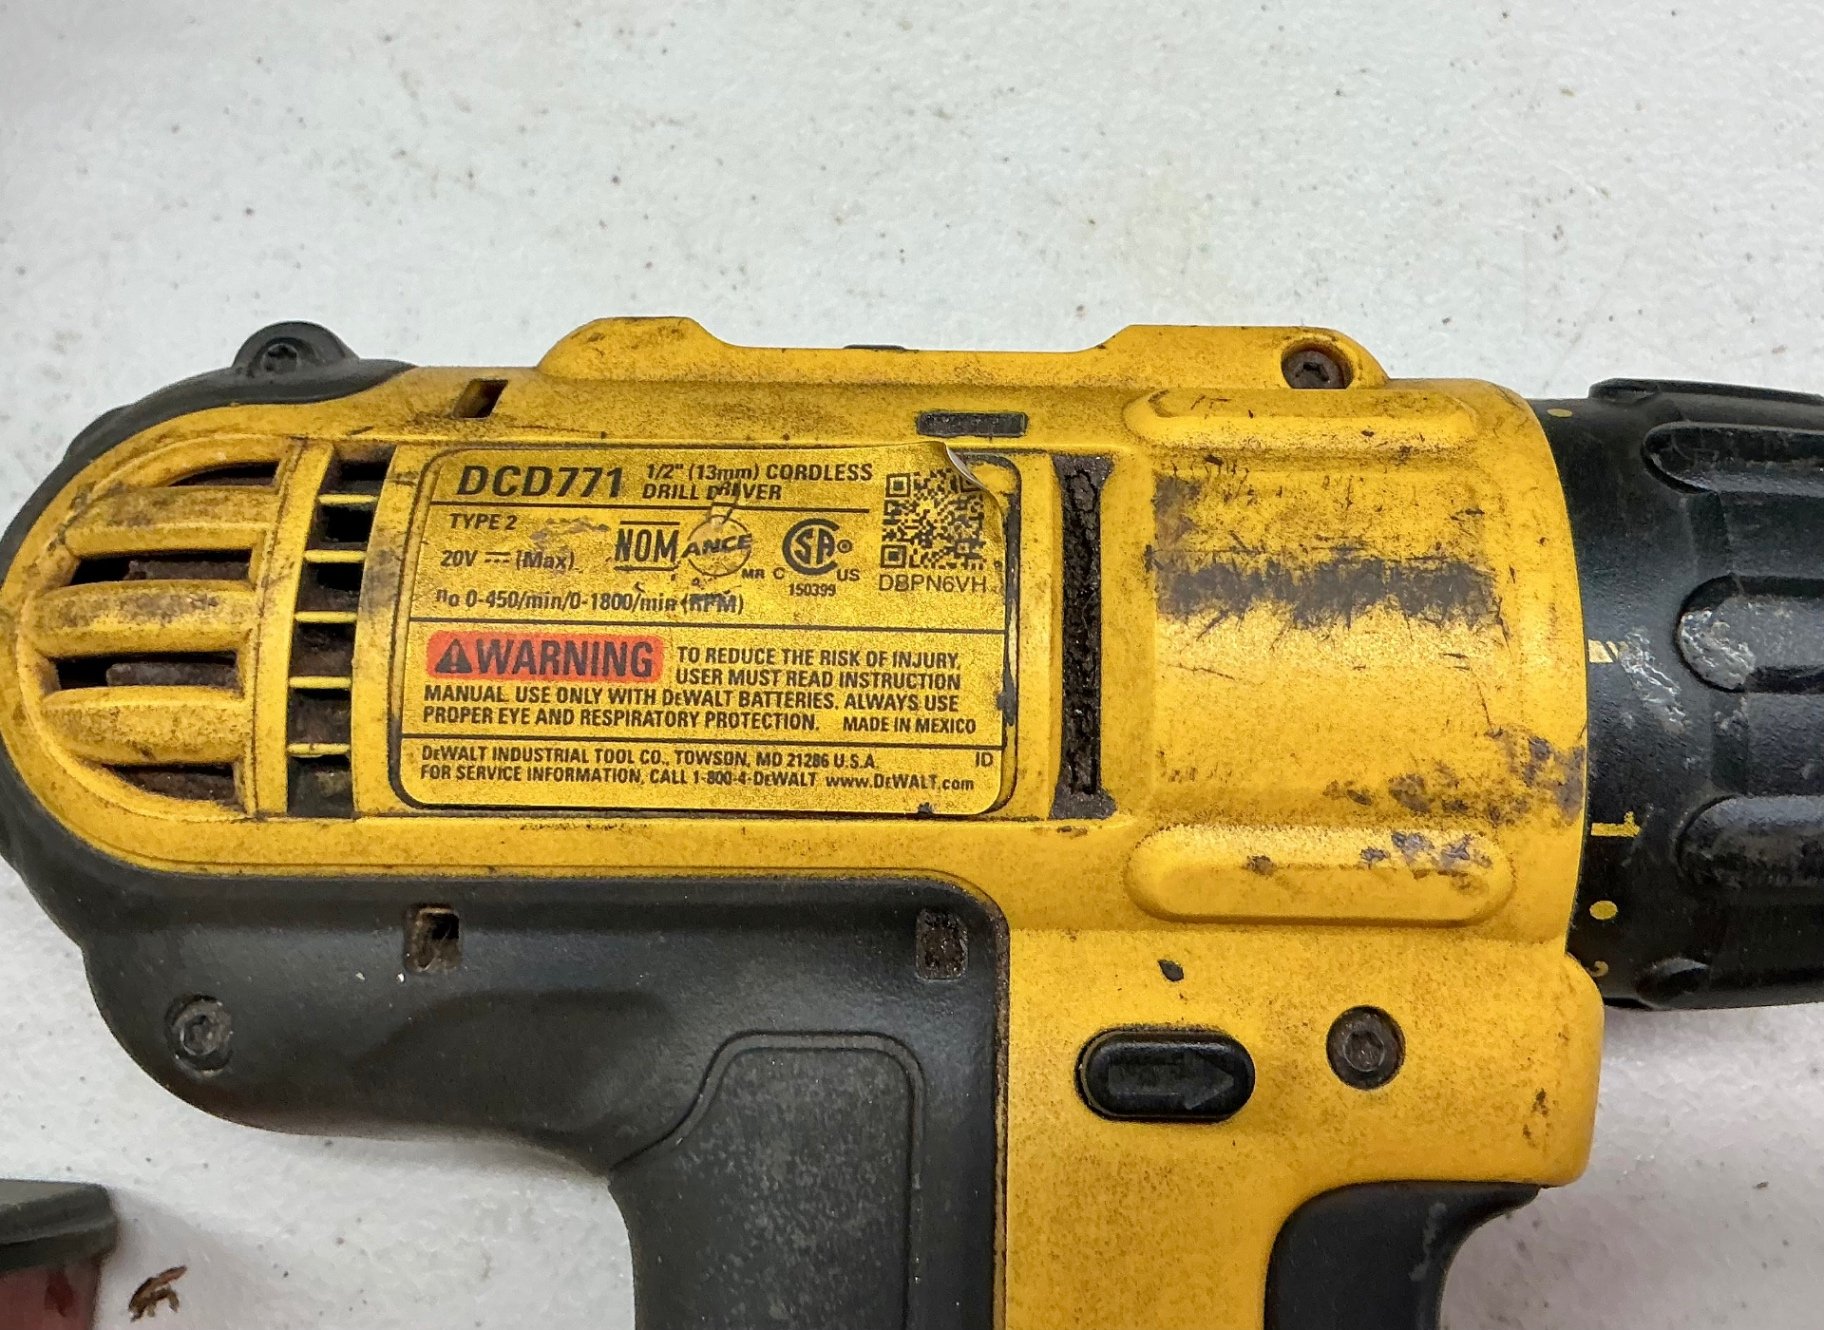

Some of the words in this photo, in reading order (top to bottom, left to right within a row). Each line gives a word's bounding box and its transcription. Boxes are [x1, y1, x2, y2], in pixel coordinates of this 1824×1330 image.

[456, 465, 623, 498] DCD771
[647, 463, 684, 480] 1/2"
[689, 463, 759, 481] (13mm)
[765, 463, 873, 481] CORDLESS
[641, 483, 699, 500] DRILL
[706, 481, 782, 500] DRIVER
[449, 512, 500, 530] TYPE
[504, 513, 518, 530] 2
[614, 528, 680, 562] NOM
[681, 533, 753, 558] ANCE
[440, 550, 478, 567] 20V
[516, 551, 575, 570] (Max)
[741, 568, 765, 579] MR
[836, 568, 860, 582] US
[789, 583, 837, 597] 150399
[879, 574, 987, 594] DBPN6VH
[475, 638, 654, 677] WARNING
[677, 646, 699, 664] TO
[705, 647, 775, 665] REDUCE
[782, 649, 813, 666] THE
[819, 650, 861, 667] RISK
[865, 651, 888, 667] OF
[675, 668, 722, 686] USER
[727, 669, 780, 687] MUST
[785, 670, 833, 688] READ
[839, 672, 961, 691] INSTRUCTION
[424, 685, 505, 703] MANUAL
[515, 686, 550, 704] USE
[556, 687, 603, 705] ONLY
[608, 688, 656, 706] WITH
[844, 693, 919, 711] ALWAYS
[924, 694, 959, 712] USE
[423, 706, 493, 724] PROPER
[497, 707, 530, 725] EYE
[535, 707, 574, 725] AND
[580, 709, 699, 728] RESPIRATORY
[704, 711, 820, 732] PROTECTION.
[842, 716, 889, 733] MADE
[893, 717, 911, 733] IN
[915, 717, 977, 735] MEXICO
[492, 747, 589, 763] INDUSTRIAL
[595, 748, 635, 764] TOOL
[756, 751, 782, 767] MD
[787, 752, 829, 768] 21286
[976, 751, 994, 767] ID
[420, 765, 451, 780] FOR
[456, 765, 522, 781] SERVICE
[527, 766, 645, 785] INFORMATION,
[651, 768, 687, 785] CALL
